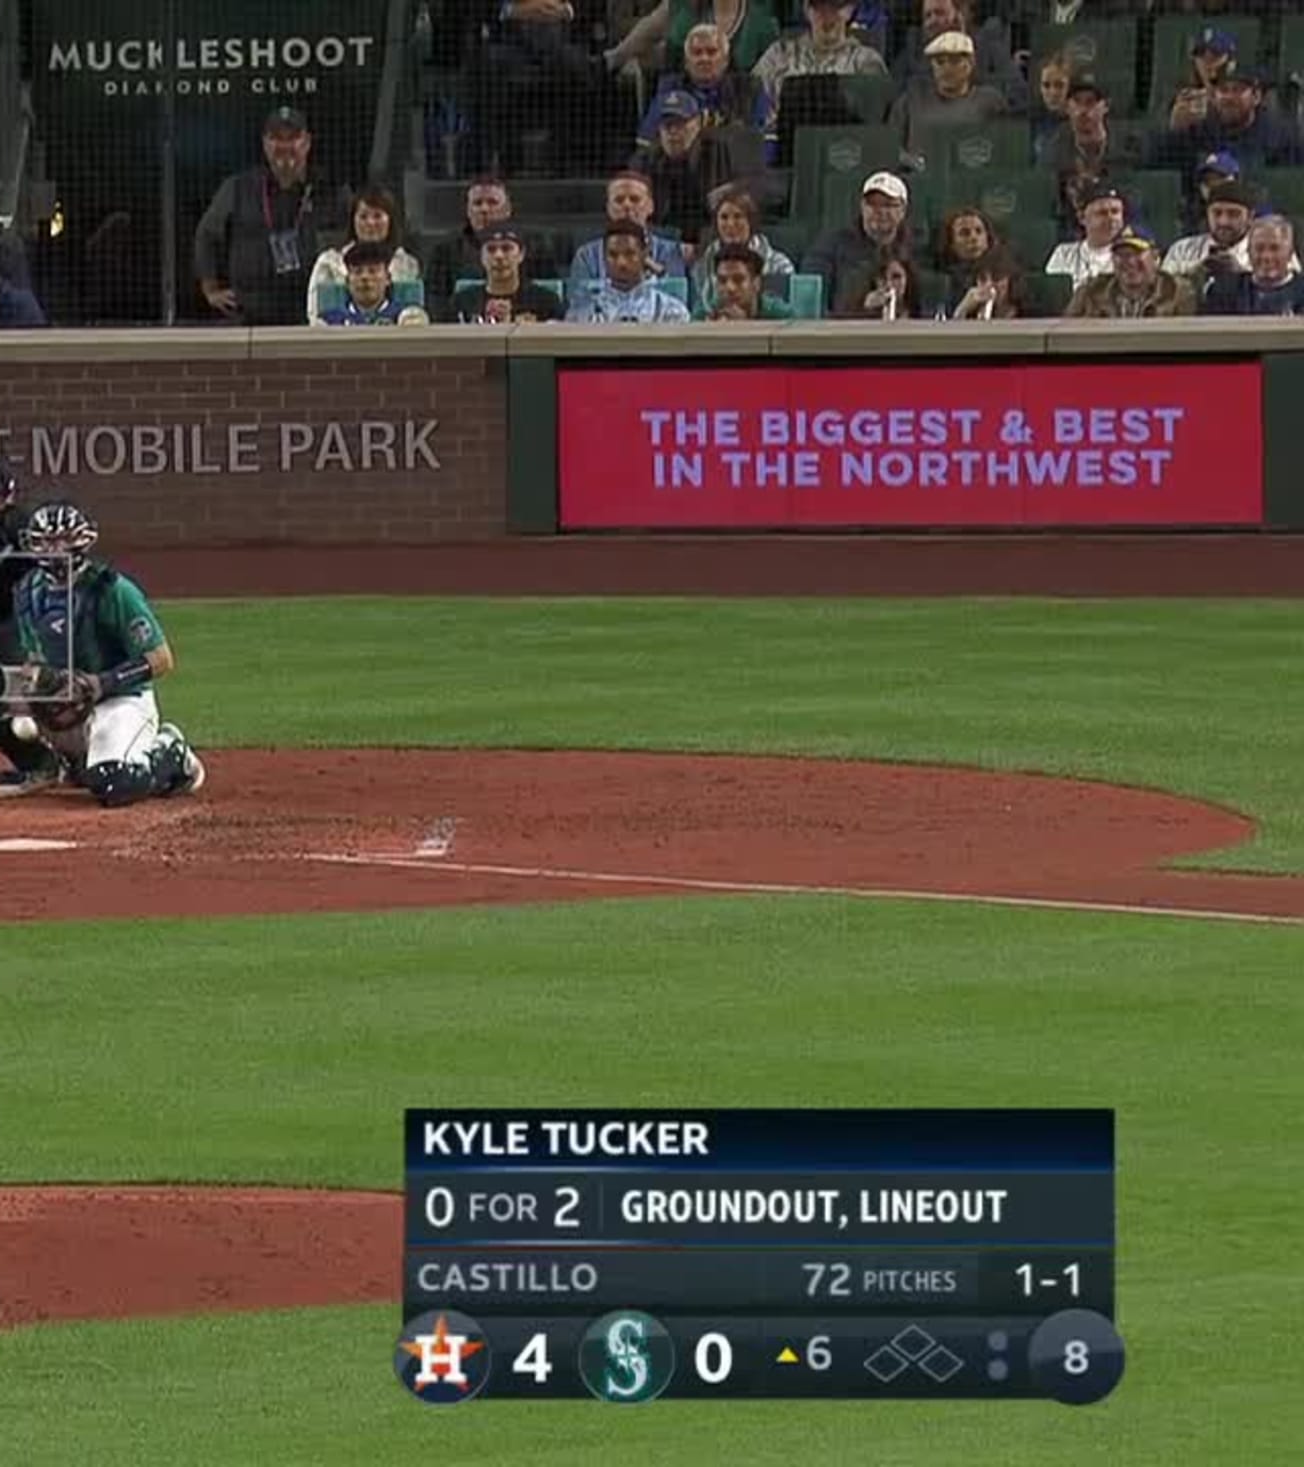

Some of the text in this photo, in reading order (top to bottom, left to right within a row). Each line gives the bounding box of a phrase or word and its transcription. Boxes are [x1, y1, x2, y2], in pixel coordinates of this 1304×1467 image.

[48, 37, 373, 71] MUCKLESHOOT
[251, 76, 317, 94] CLUB
[641, 407, 1184, 446] THE BIGGEST & BEST
[280, 419, 441, 473] PARK
[654, 449, 1171, 487] IN THE NORTHWEST
